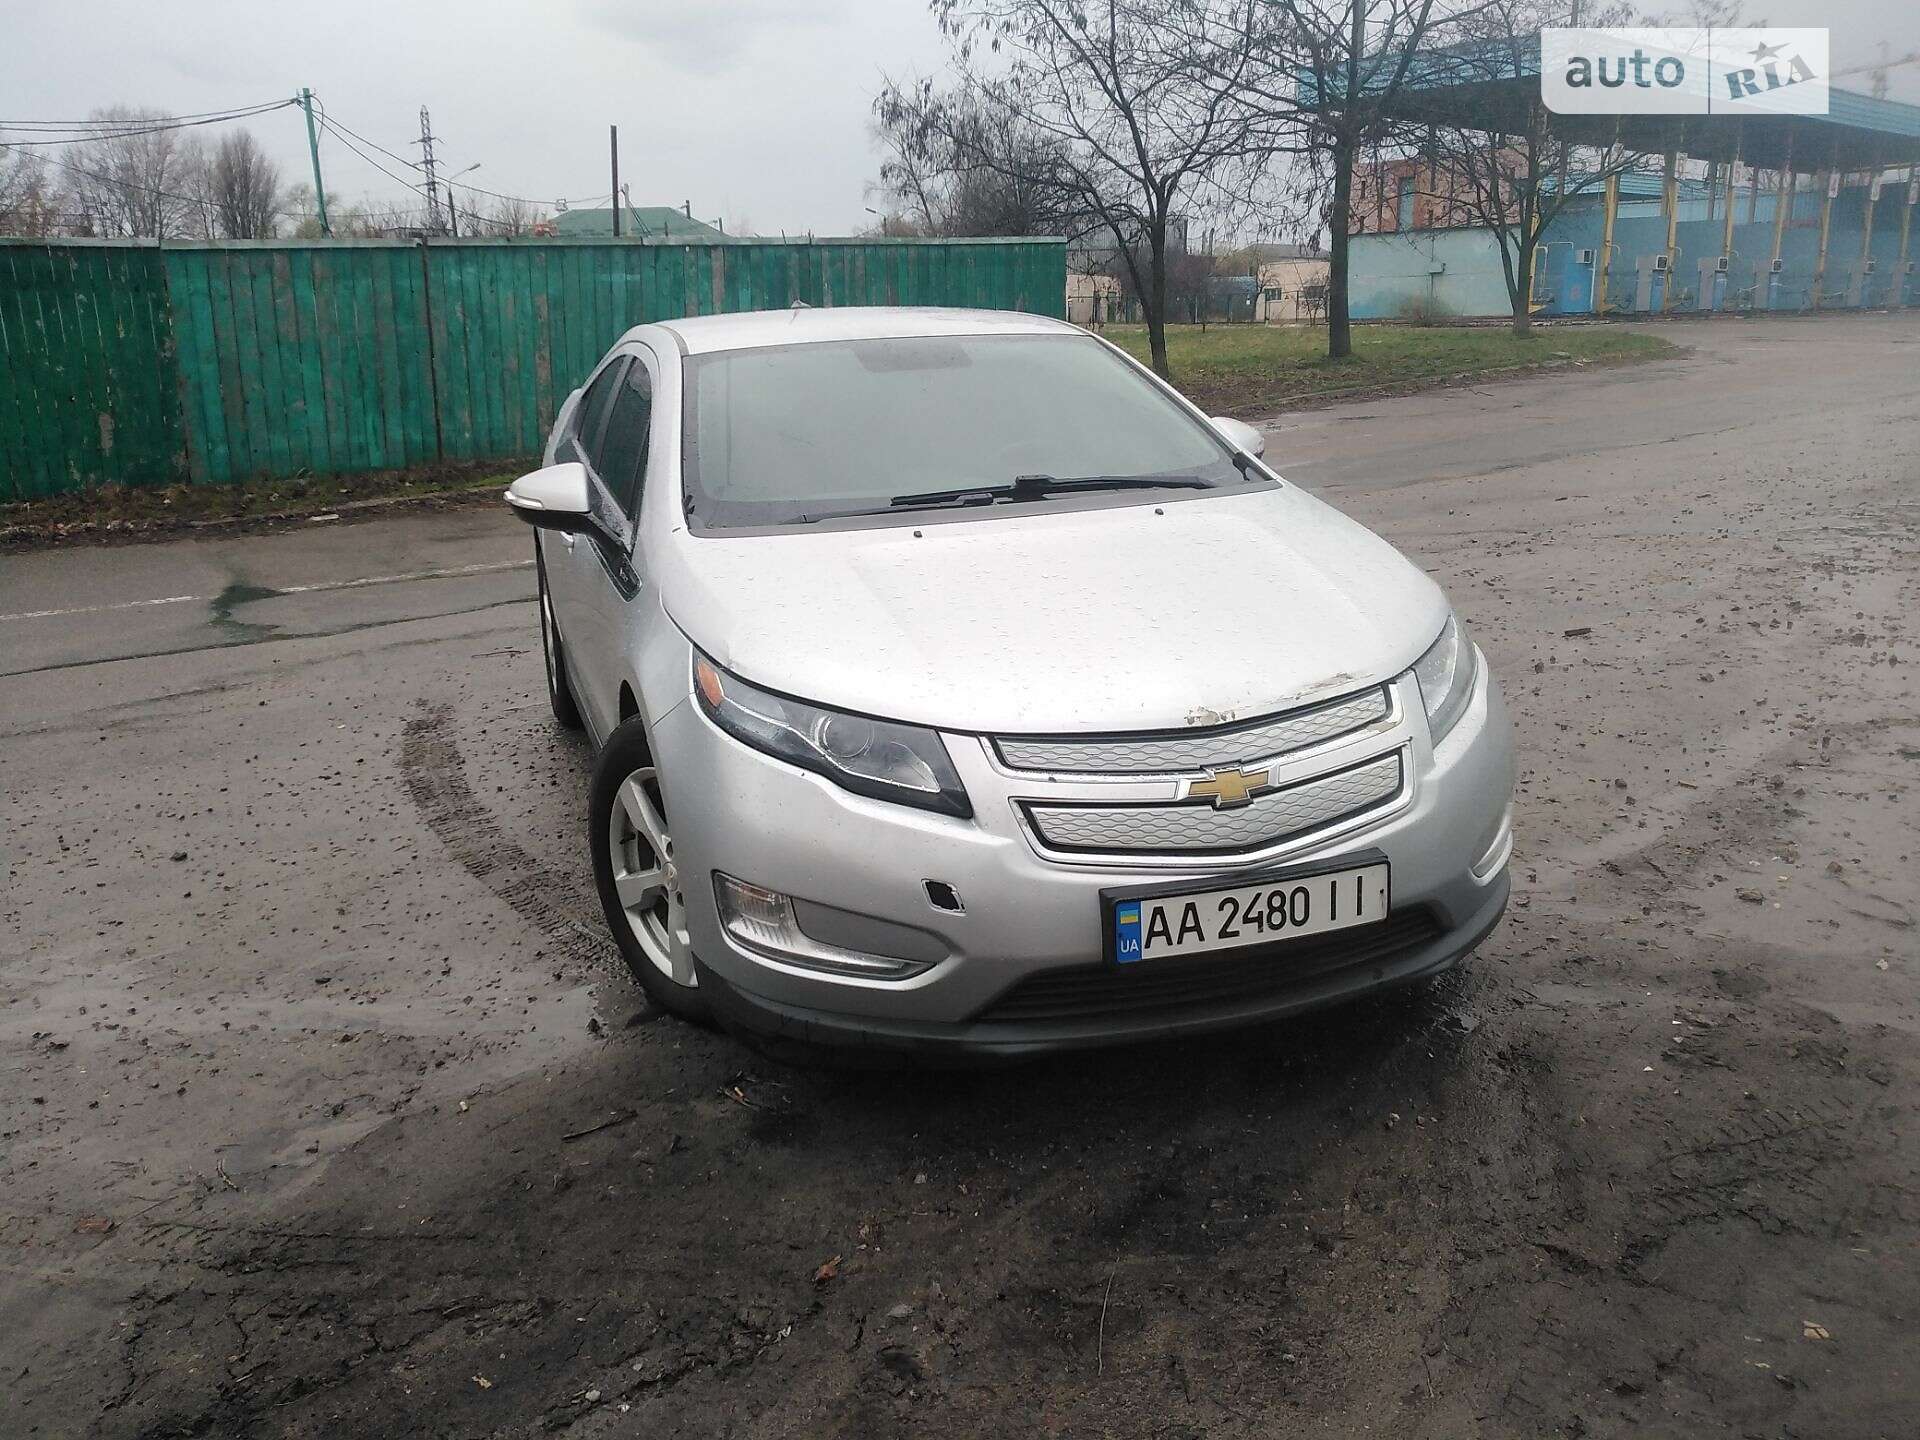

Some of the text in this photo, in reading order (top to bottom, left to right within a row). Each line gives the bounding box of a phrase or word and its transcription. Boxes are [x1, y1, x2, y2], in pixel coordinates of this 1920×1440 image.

[1144, 902, 1205, 949] AA
[1217, 886, 1310, 939] 2480
[1120, 938, 1140, 953] UA
